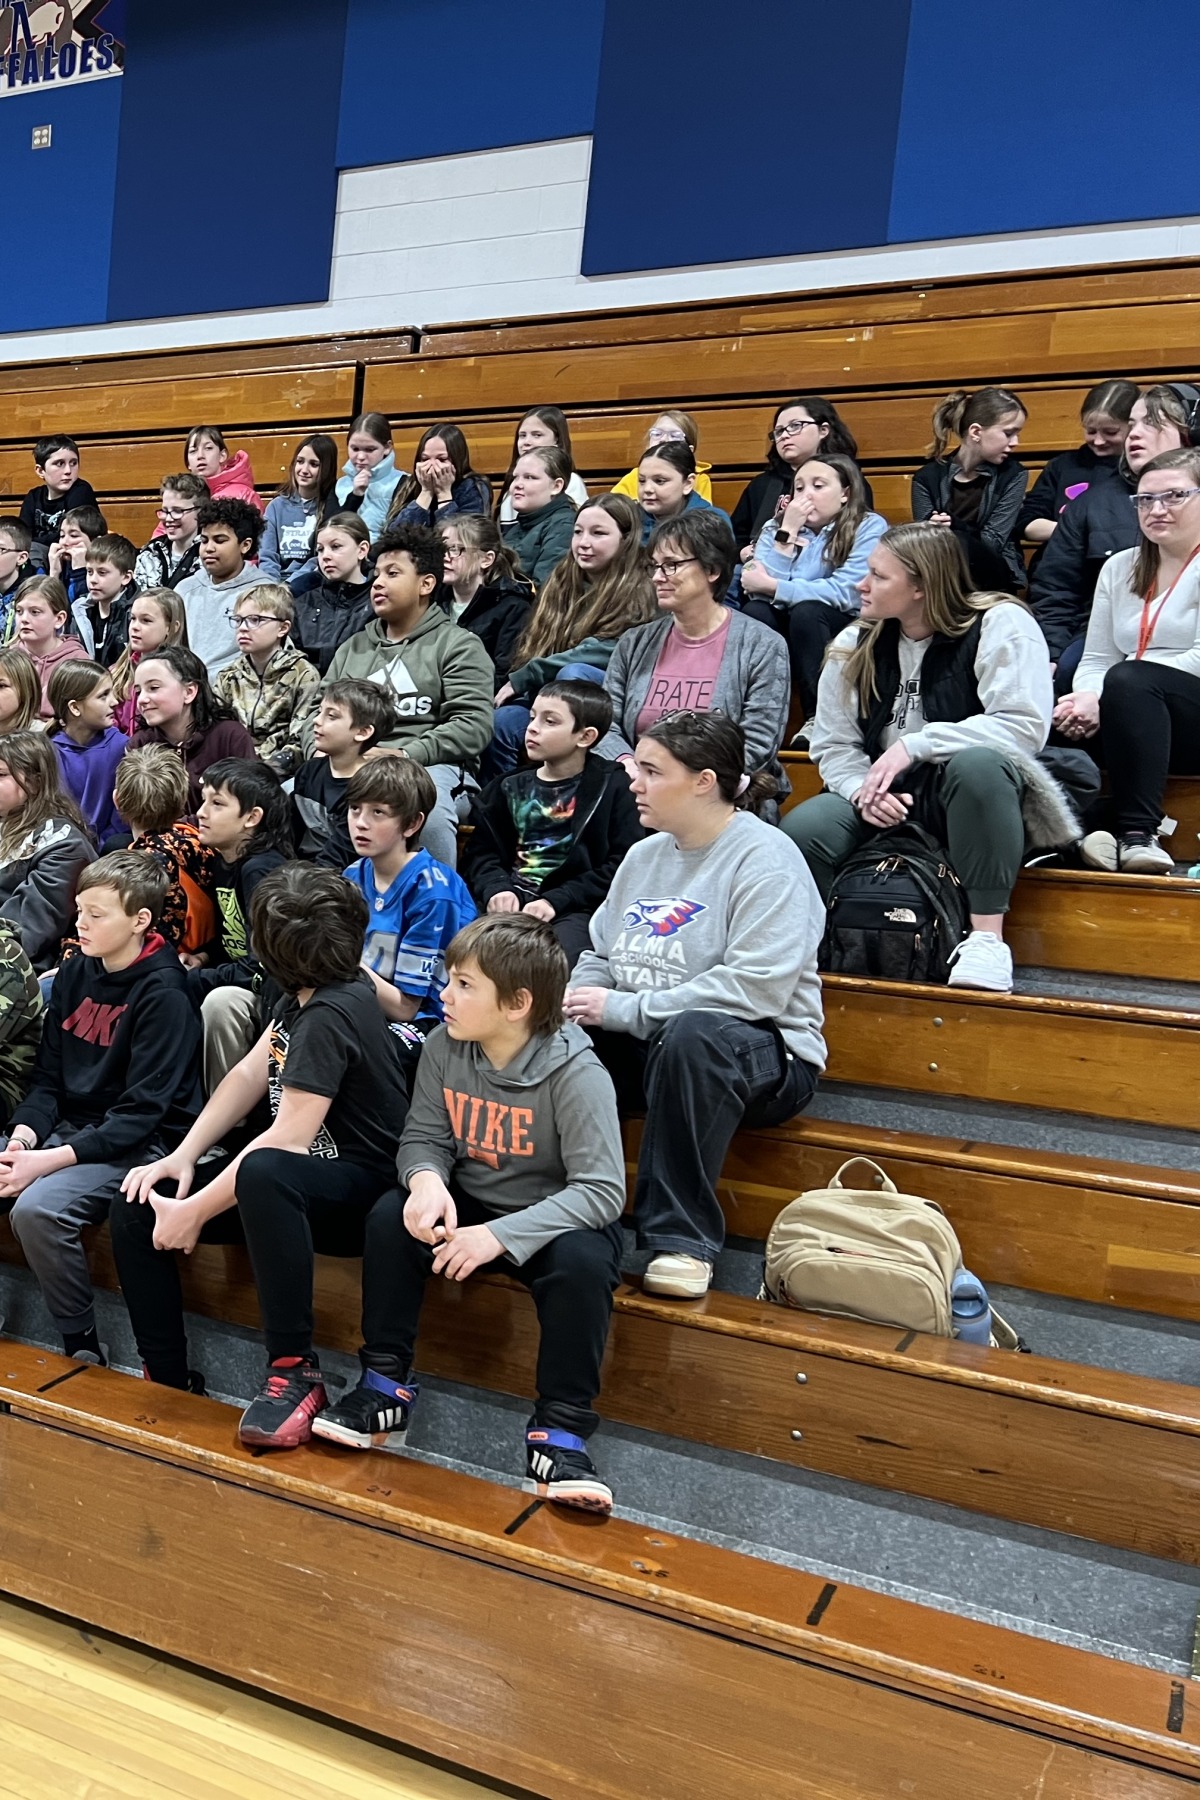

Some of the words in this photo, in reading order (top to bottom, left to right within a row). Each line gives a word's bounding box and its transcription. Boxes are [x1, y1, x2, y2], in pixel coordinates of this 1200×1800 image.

[644, 679, 713, 709] RATE
[422, 866, 449, 889] 14
[611, 932, 687, 965] ALMA
[620, 952, 670, 971] SCHOOL
